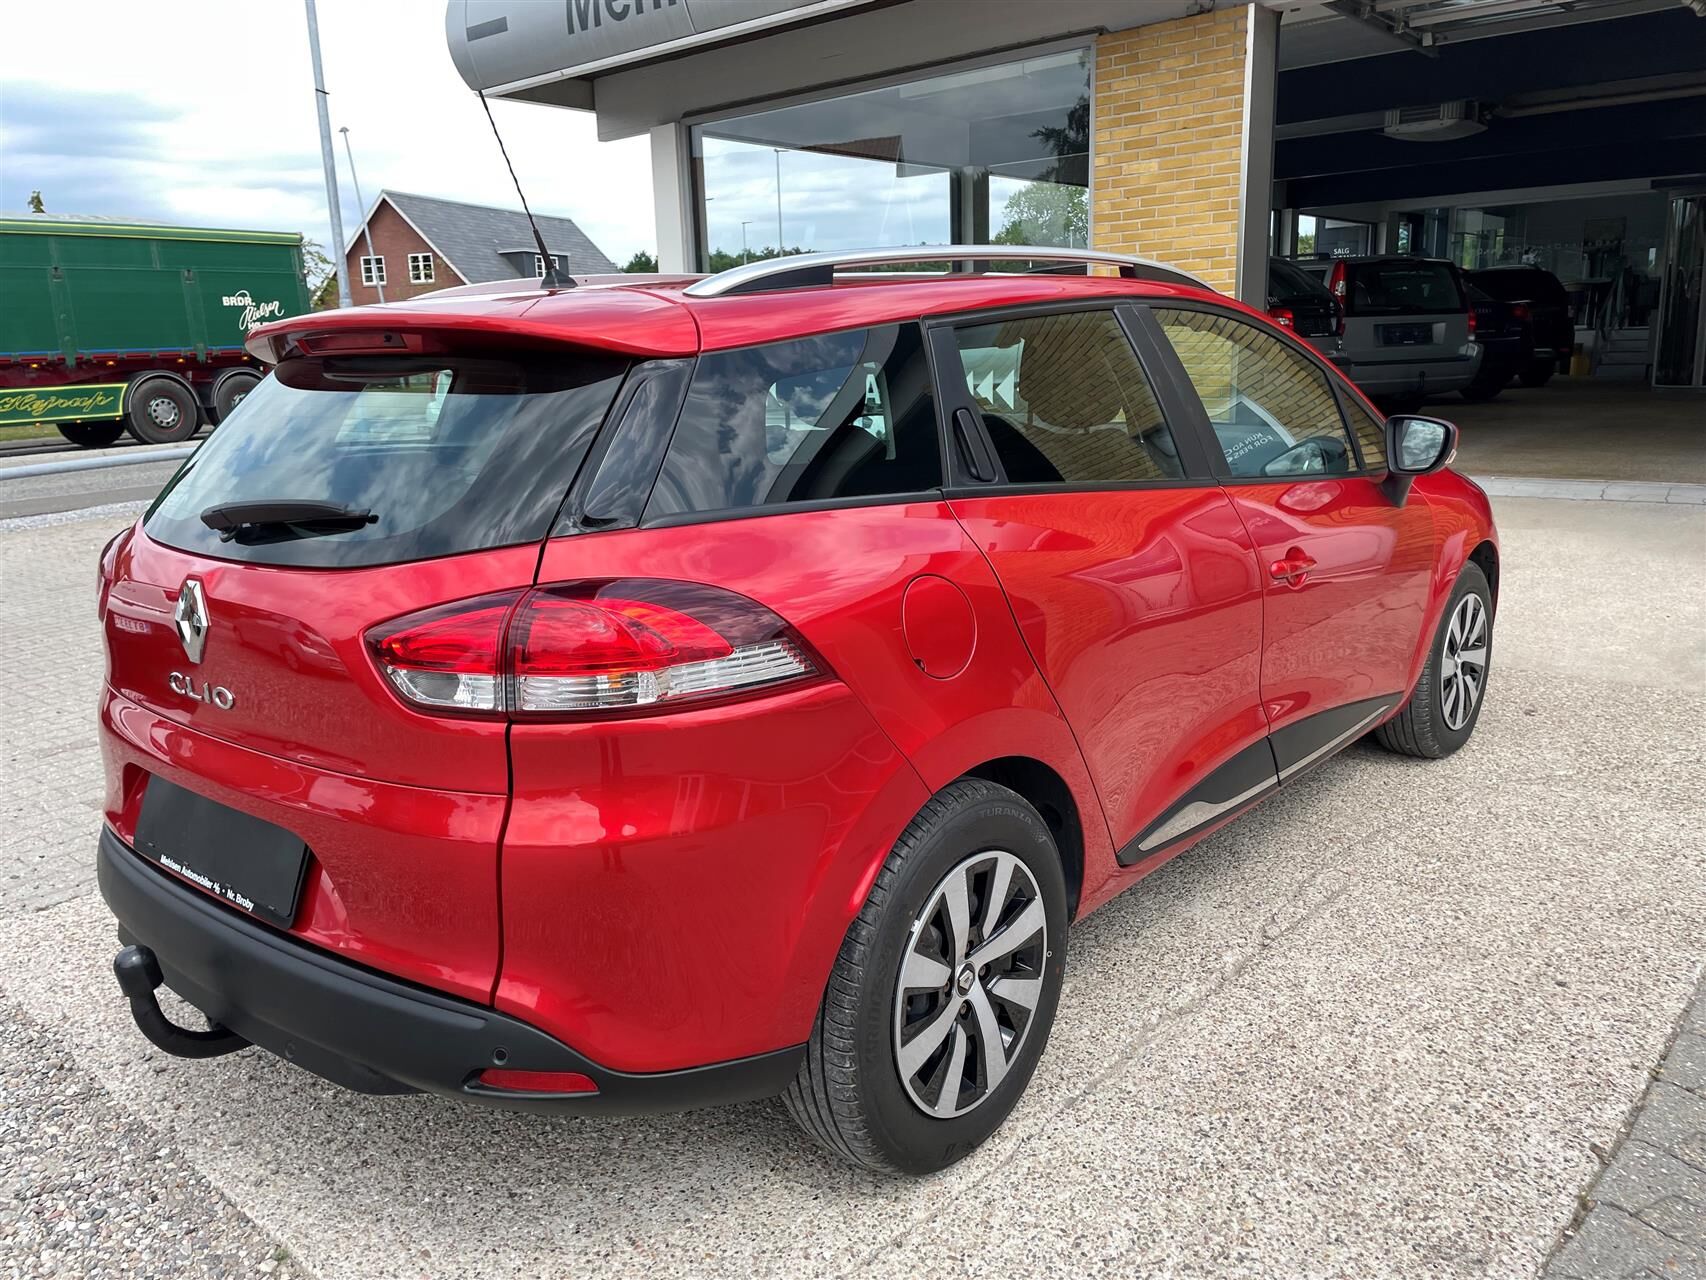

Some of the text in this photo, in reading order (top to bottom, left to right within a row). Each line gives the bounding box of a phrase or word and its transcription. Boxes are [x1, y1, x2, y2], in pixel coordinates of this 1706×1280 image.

[1333, 247, 1350, 255] SALG
[222, 295, 256, 307] BRDR.
[169, 671, 236, 710] CLIO
[979, 807, 1033, 825] TURANZA
[160, 853, 182, 873] Mehlsen
[181, 865, 213, 890] Automobiler
[226, 888, 236, 902] Nr.
[235, 893, 254, 912] Broby
